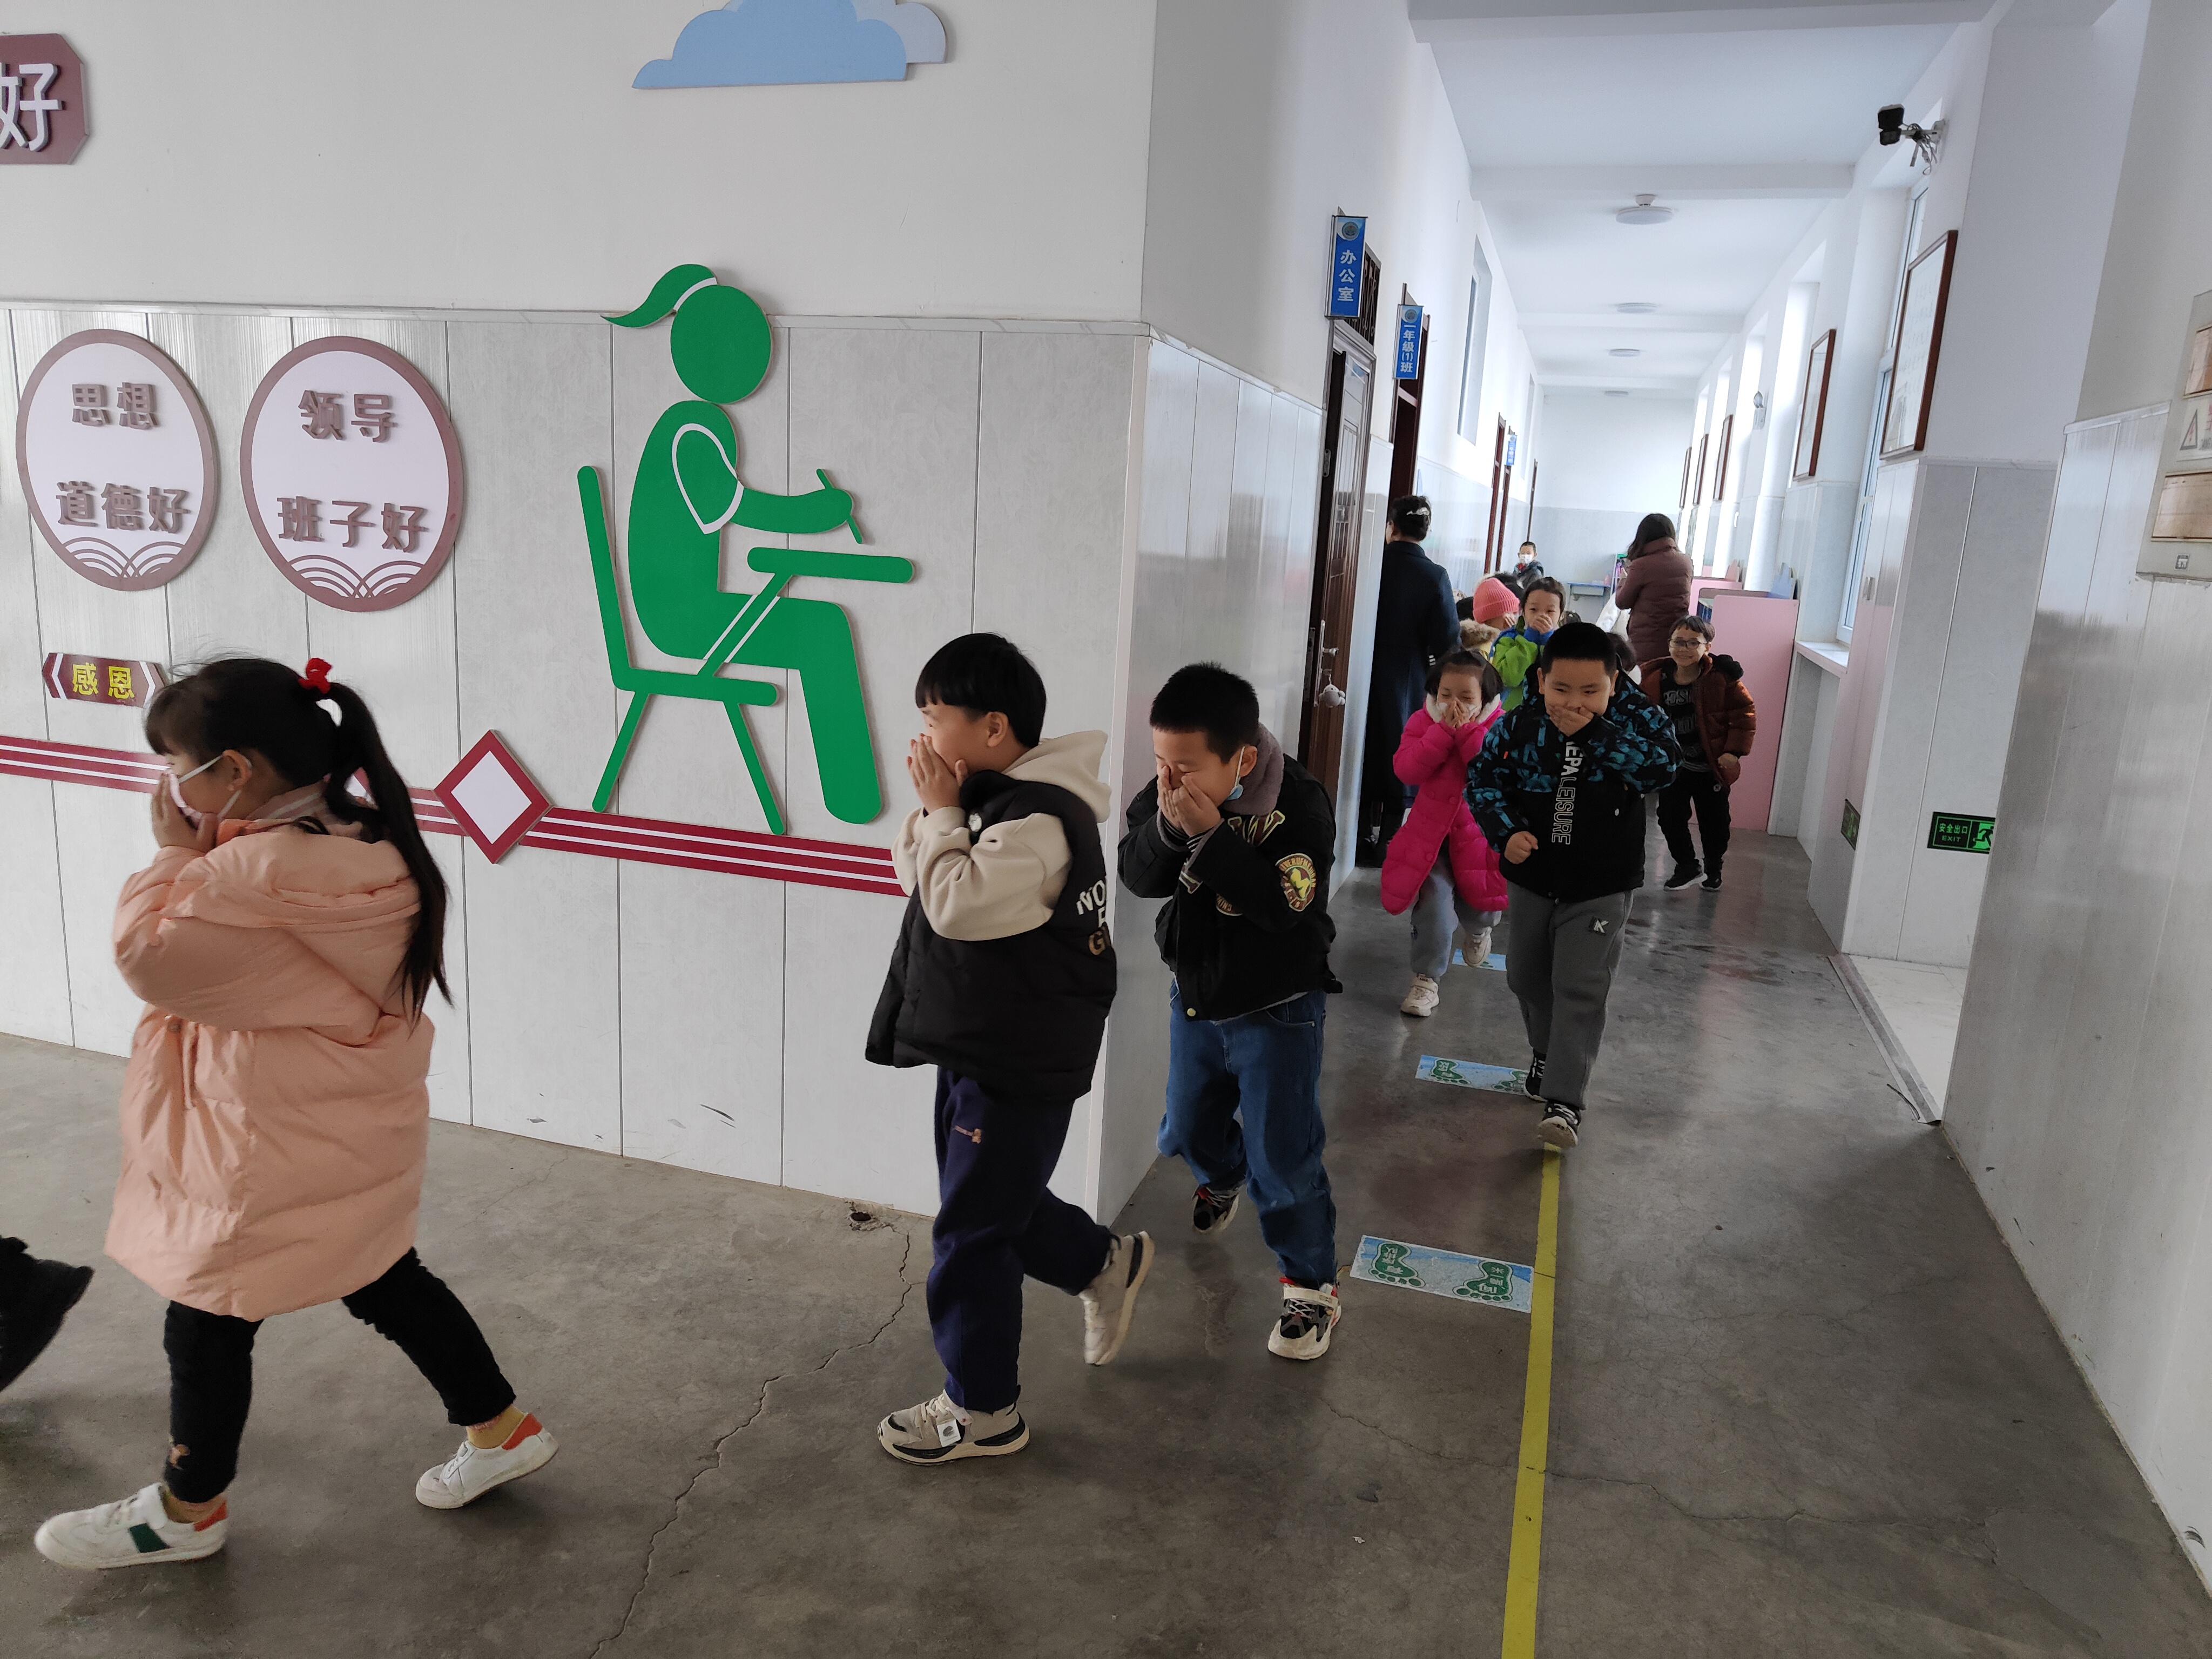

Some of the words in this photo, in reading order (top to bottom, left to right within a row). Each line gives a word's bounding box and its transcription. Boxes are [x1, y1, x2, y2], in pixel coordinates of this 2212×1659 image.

[1337, 249, 1357, 302] 办公室
[72, 382, 158, 430] 思想
[298, 390, 397, 443] 领导
[56, 481, 193, 534] 道德好
[277, 496, 429, 554] 班子好
[72, 662, 135, 699] 感恩
[1939, 822, 1968, 834] 安全出口
